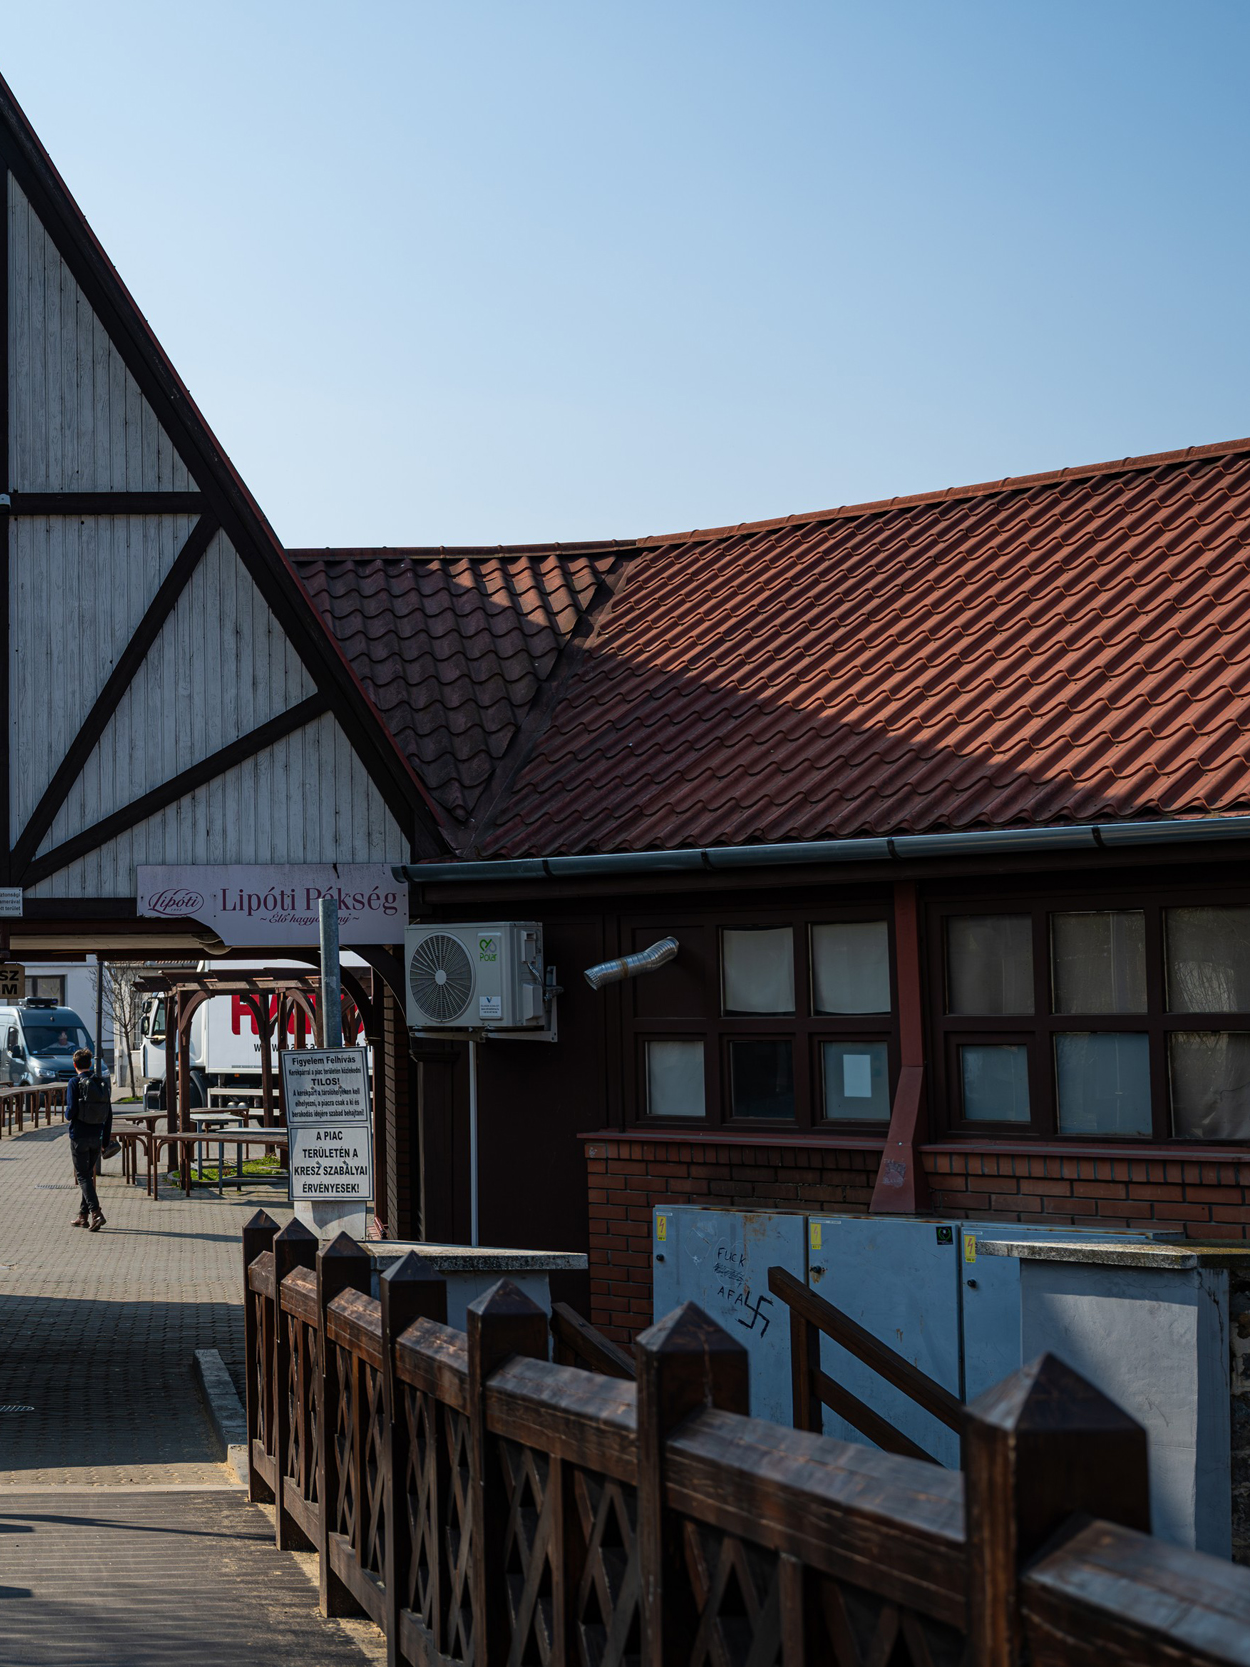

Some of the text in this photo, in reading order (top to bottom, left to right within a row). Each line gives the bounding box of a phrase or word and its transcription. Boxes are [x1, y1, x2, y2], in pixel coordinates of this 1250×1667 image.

[152, 889, 200, 912] Lipóti
[220, 886, 296, 916] Lipóti
[290, 913, 349, 926] hagyony
[292, 1055, 356, 1067] Figyelem Felhívás
[311, 1078, 340, 1086] TILOS!
[316, 1131, 343, 1141] A PIAC
[302, 1146, 359, 1158] TERÜLETÉN A
[294, 1164, 368, 1176] KRESZ SZABÁLYAI
[302, 1181, 360, 1193] ÉRVÉNYESEK!
[717, 1247, 747, 1268] FUCK
